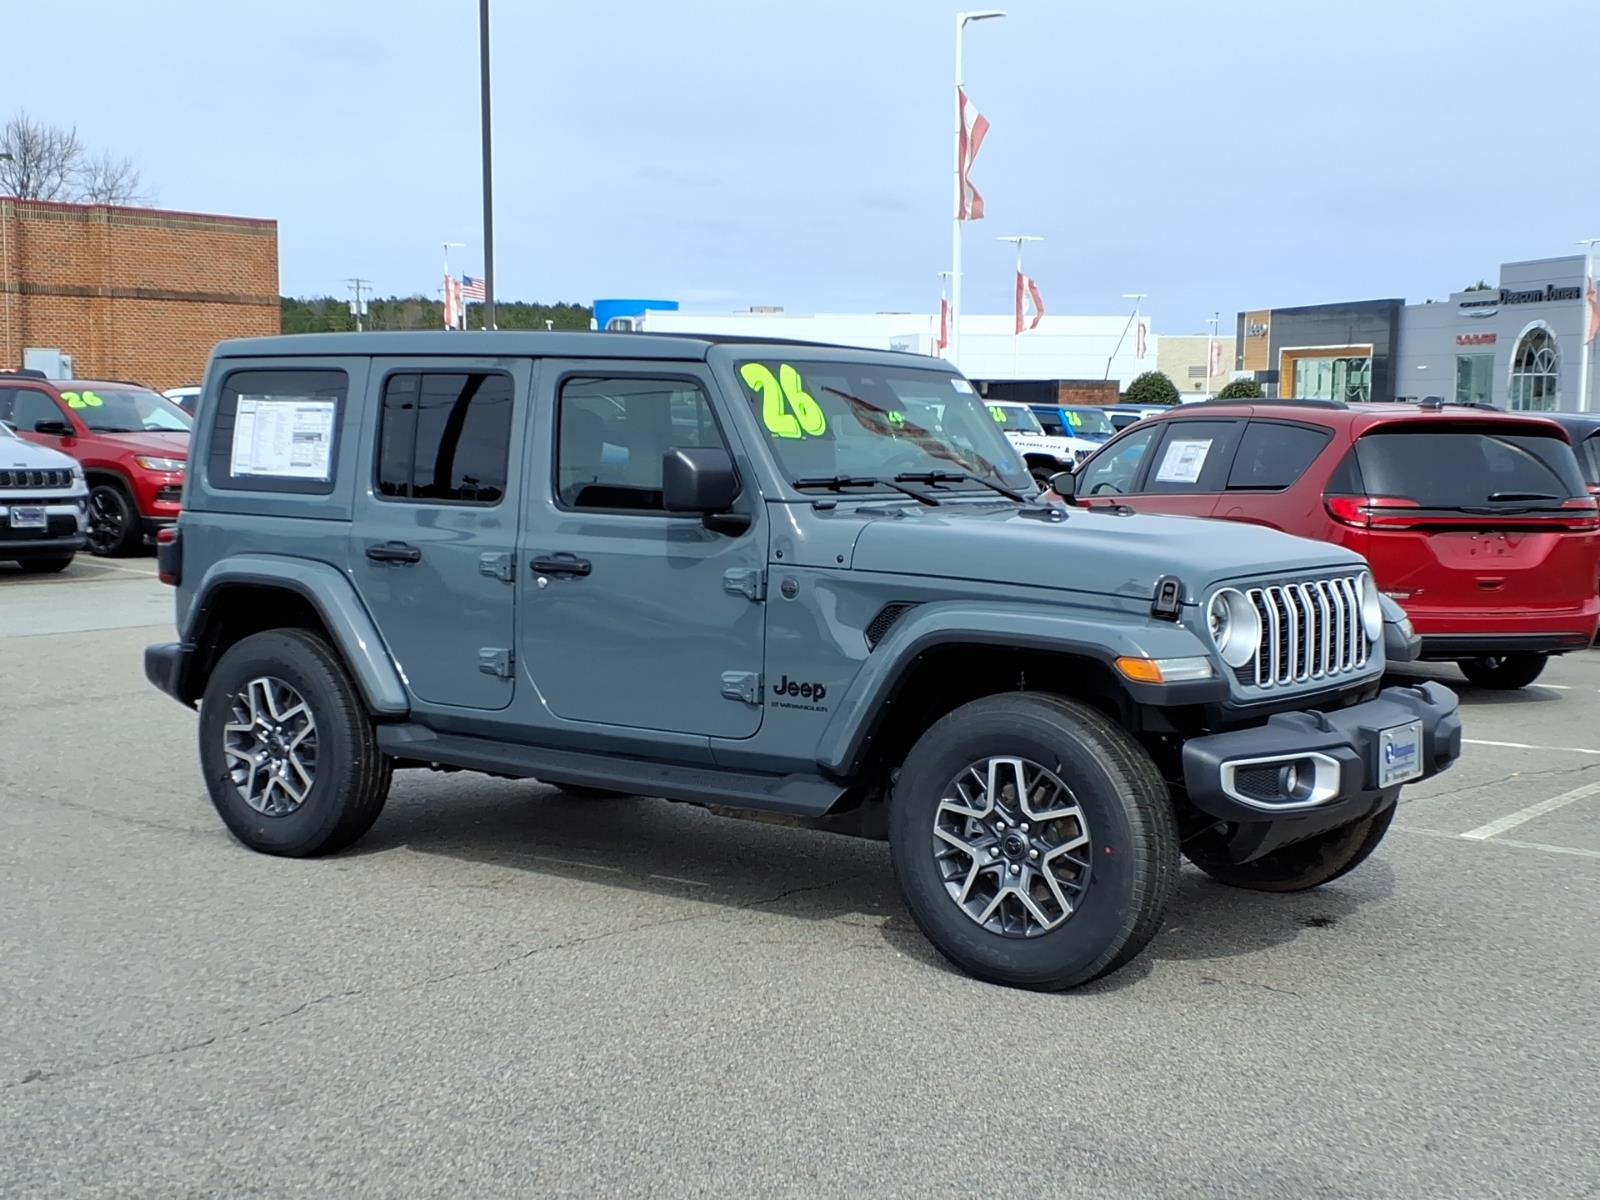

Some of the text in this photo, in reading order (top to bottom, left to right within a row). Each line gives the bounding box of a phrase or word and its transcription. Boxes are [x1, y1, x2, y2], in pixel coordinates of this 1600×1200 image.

[60, 391, 103, 408] 26
[740, 363, 826, 438] 26
[988, 406, 1007, 423] 26
[773, 675, 826, 702] Jeep
